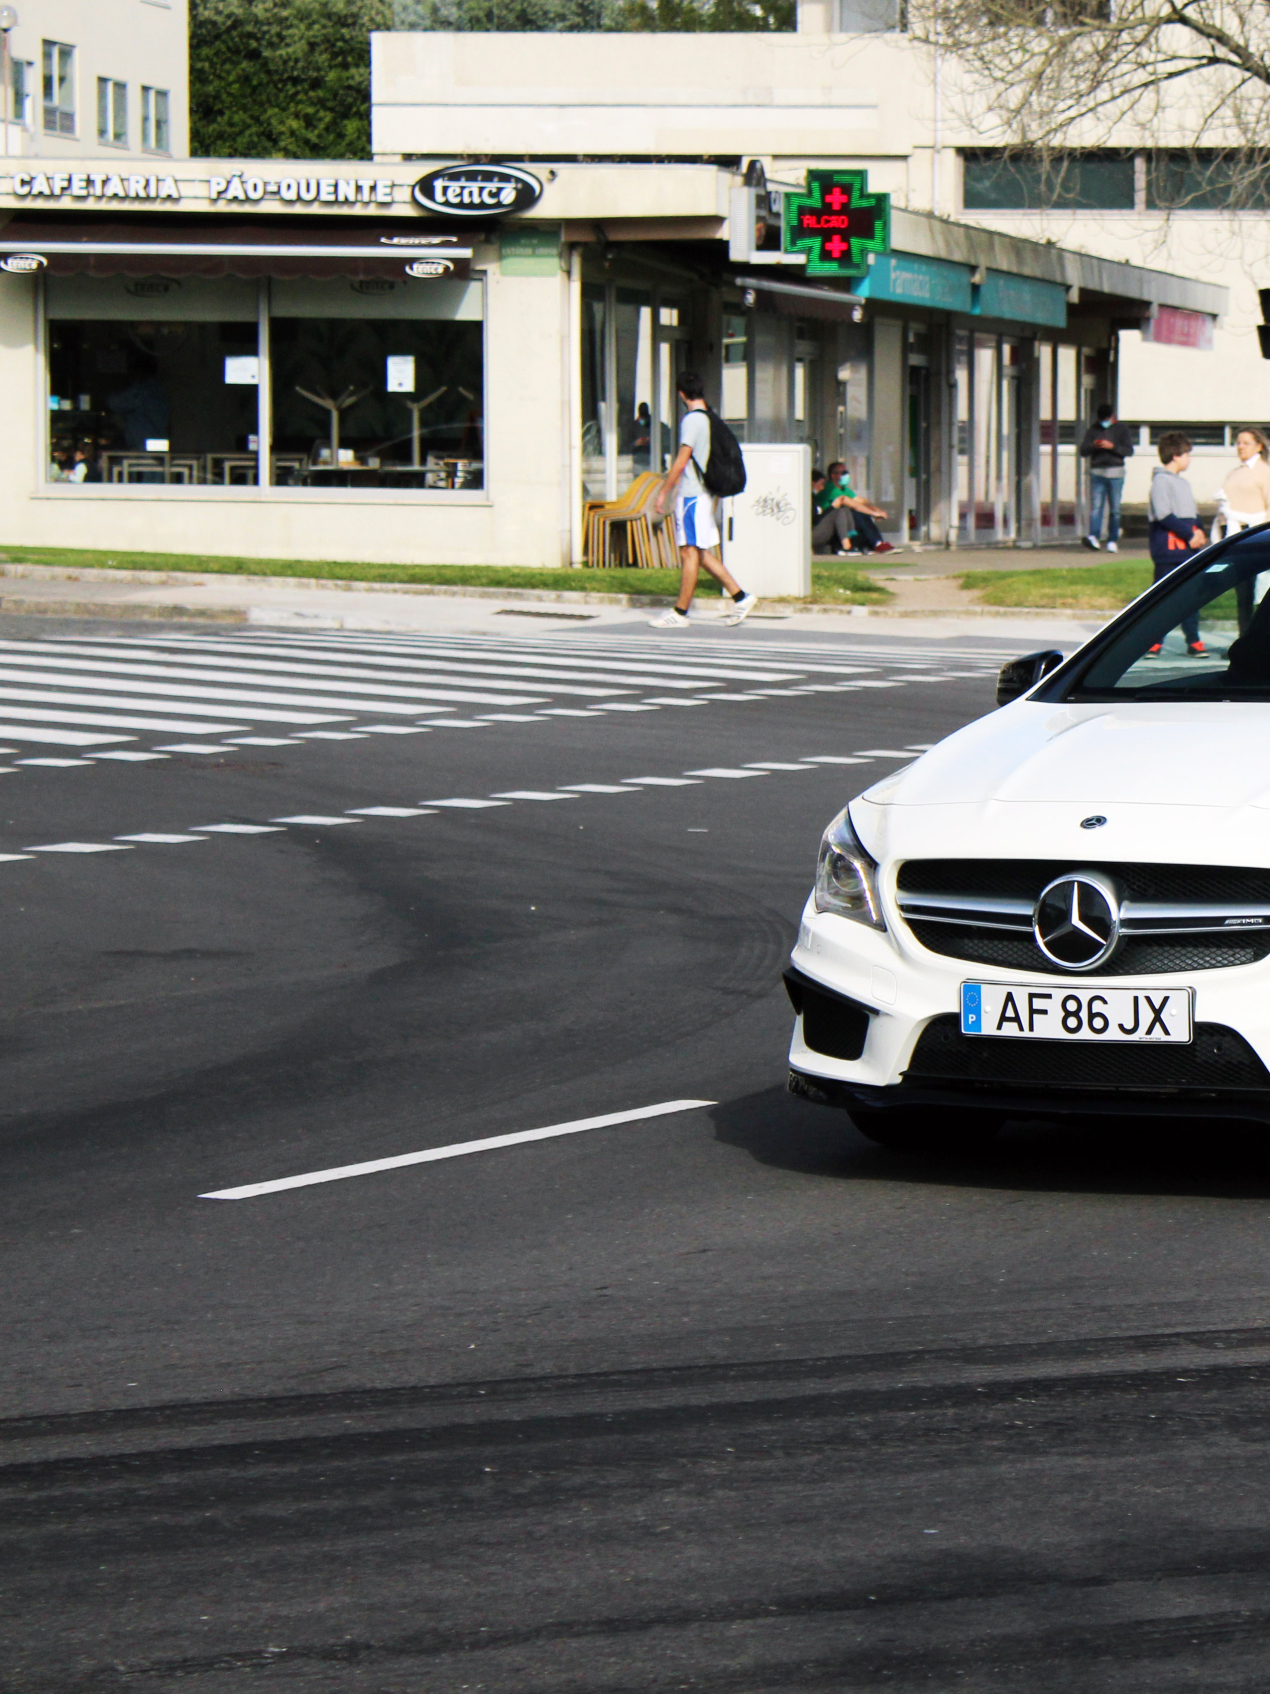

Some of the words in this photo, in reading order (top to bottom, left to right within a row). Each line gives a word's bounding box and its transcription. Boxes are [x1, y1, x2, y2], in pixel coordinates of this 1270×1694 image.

[13, 173, 181, 199] CAFETARIA
[209, 171, 394, 203] PÃO-QUENTE
[432, 178, 517, 205] tenco
[968, 1014, 977, 1025] P
[996, 991, 1053, 1033] AF
[1061, 994, 1110, 1035] 86
[1118, 995, 1171, 1036] JX
